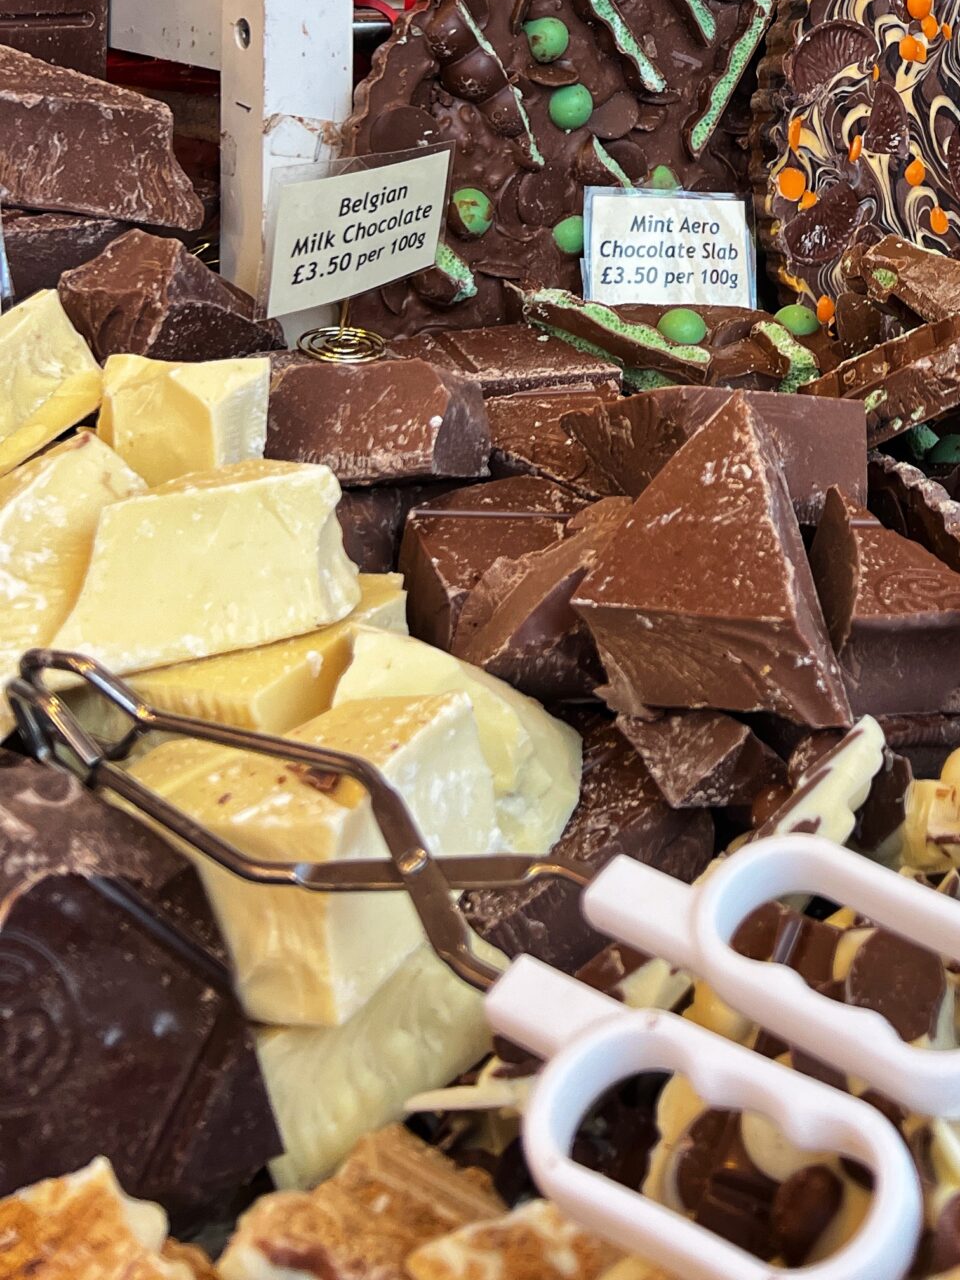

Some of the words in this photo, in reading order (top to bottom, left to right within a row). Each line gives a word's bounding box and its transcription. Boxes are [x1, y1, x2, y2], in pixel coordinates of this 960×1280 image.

[338, 185, 409, 218] Belgian
[290, 230, 336, 258] Milk
[342, 204, 433, 245] Chocolate
[629, 214, 674, 233] Mint
[678, 216, 721, 235] Aero
[291, 252, 353, 286] £3.50
[355, 246, 386, 271] per
[390, 232, 427, 255] 100g
[599, 240, 697, 259] Chocolate
[701, 242, 739, 260] Slab
[600, 266, 658, 285] £3.50
[663, 270, 695, 288] per
[700, 269, 739, 289] 100g
